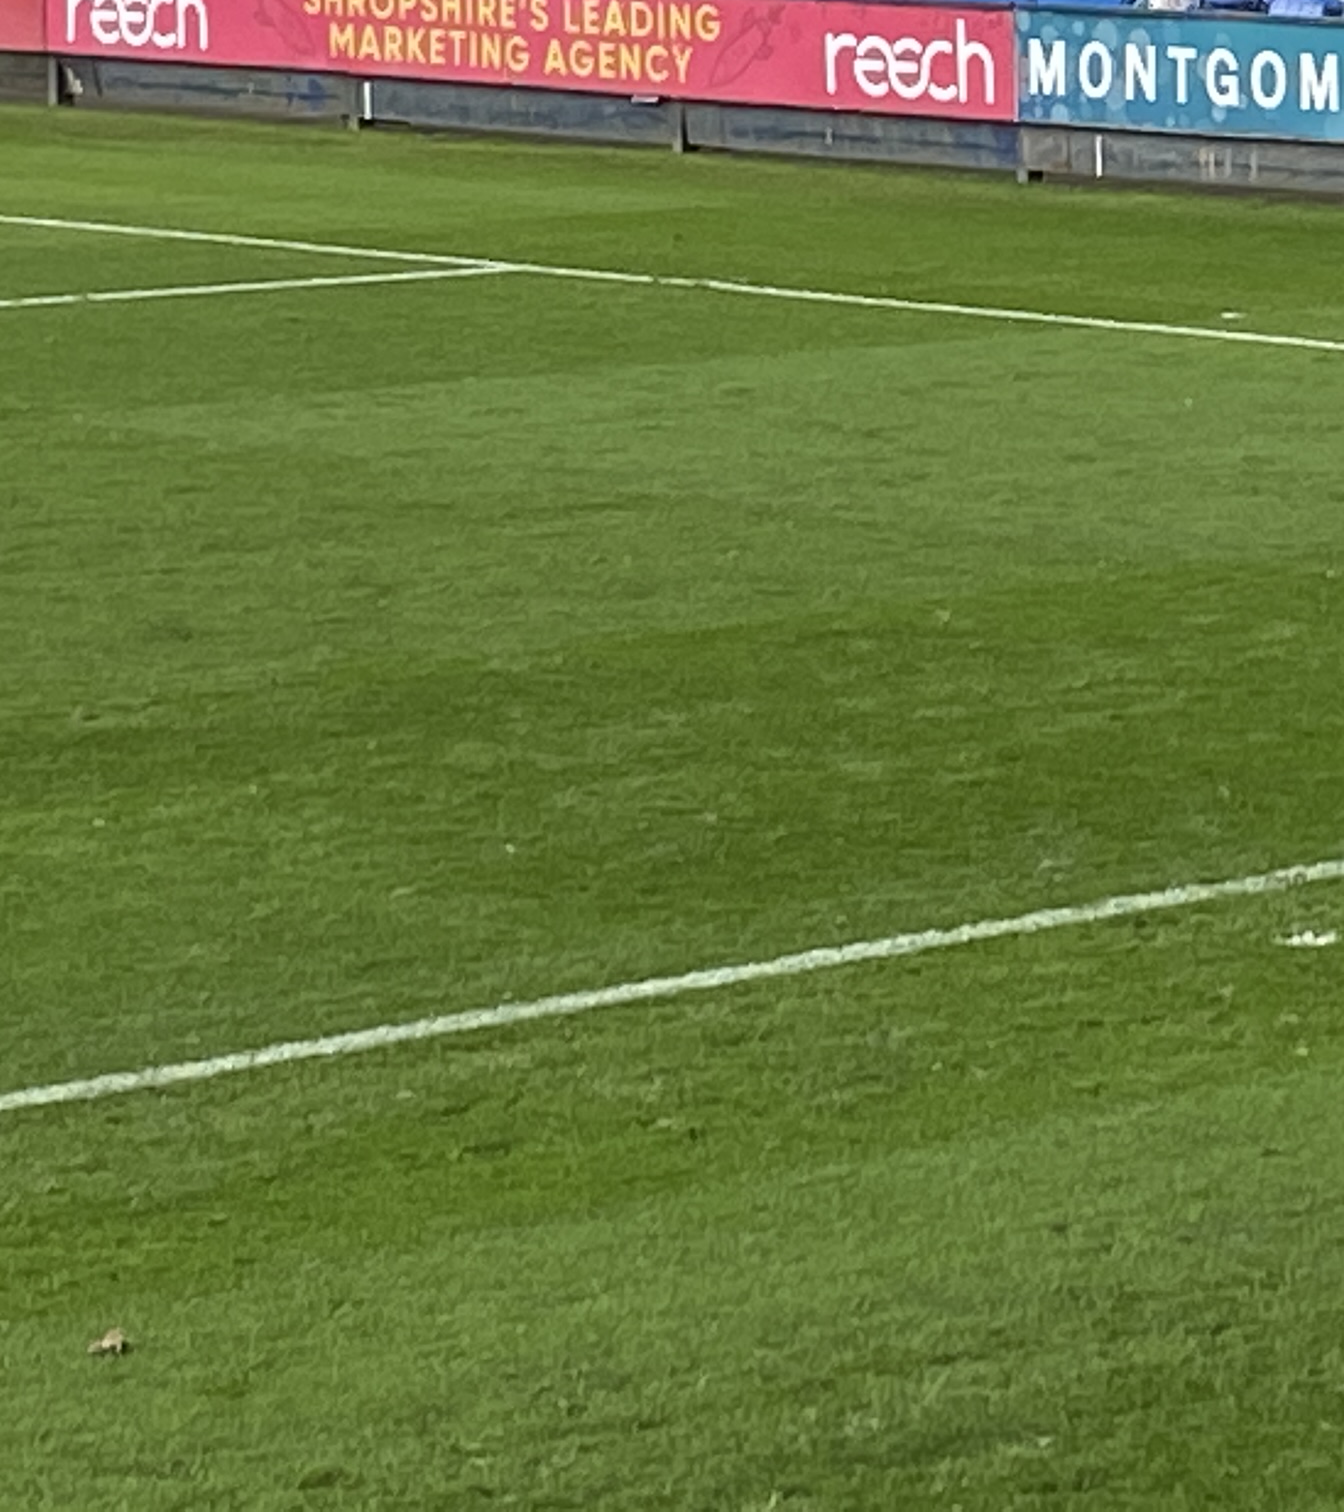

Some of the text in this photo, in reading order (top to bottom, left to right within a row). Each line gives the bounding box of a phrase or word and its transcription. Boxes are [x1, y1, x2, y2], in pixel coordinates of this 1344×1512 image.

[328, 22, 693, 84] MARKETING AGENCY
[825, 18, 995, 105] reech
